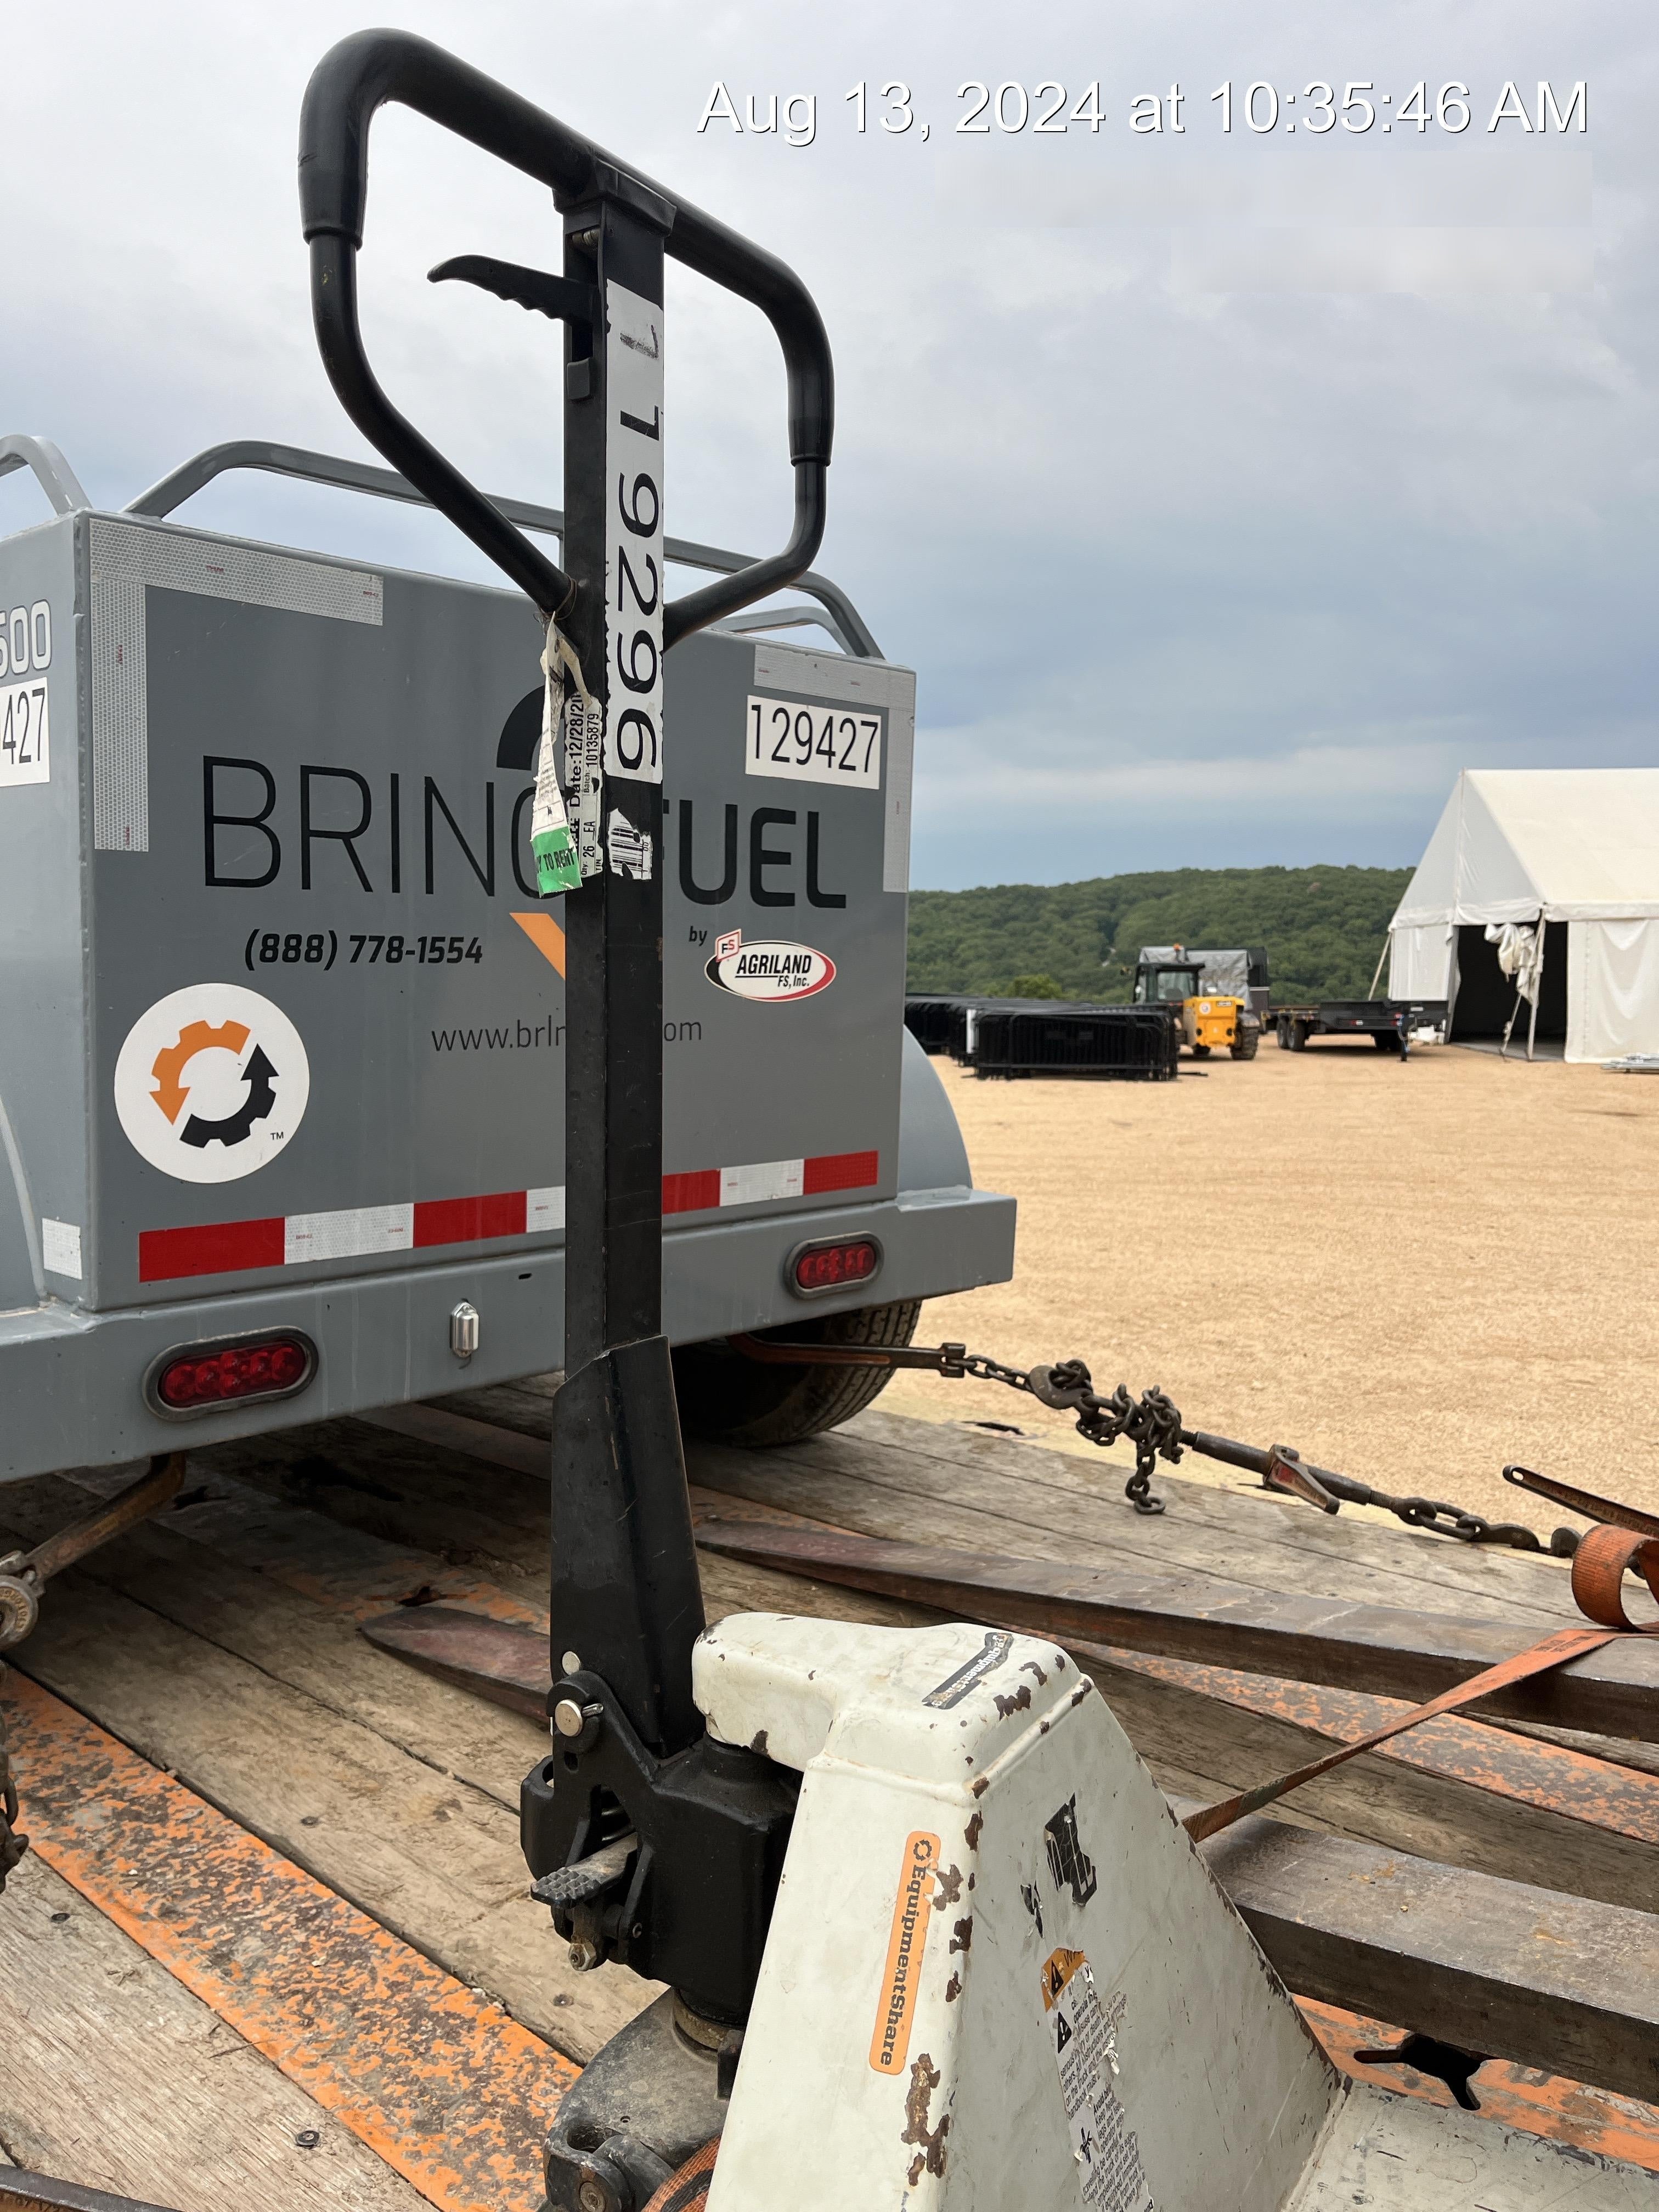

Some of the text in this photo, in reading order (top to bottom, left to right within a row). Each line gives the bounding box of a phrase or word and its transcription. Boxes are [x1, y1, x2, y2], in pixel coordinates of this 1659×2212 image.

[585, 713, 600, 768] 10135879
[751, 704, 878, 772] 129427
[583, 845, 595, 858] 26
[663, 799, 847, 909] UEL
[689, 926, 708, 946] by
[721, 939, 735, 954] FS
[245, 928, 483, 972] (888) 778-1554
[736, 954, 812, 975] AGRILAND
[793, 975, 810, 988] Inc.
[269, 1130, 285, 1141] TM
[880, 1864, 927, 2066] EquipmentShare
